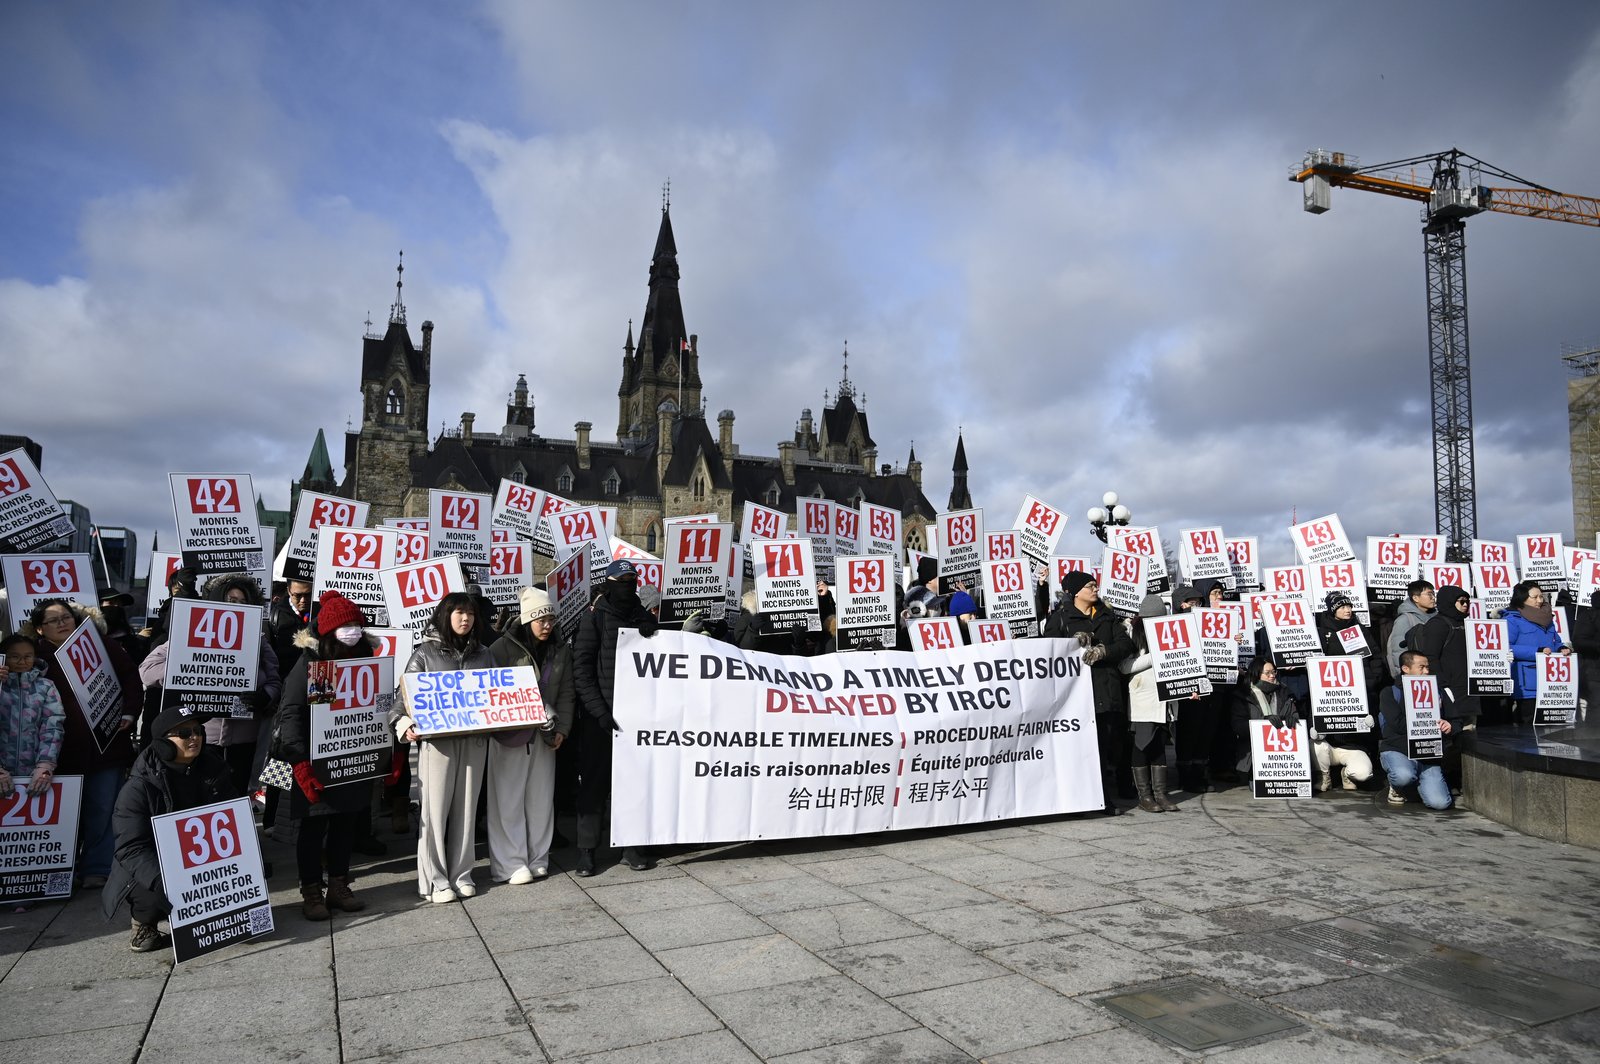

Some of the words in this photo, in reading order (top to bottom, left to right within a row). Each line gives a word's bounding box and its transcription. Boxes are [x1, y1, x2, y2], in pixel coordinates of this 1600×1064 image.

[196, 480, 235, 512] 42
[508, 487, 532, 510] 25
[199, 517, 238, 525] MONTHS
[315, 501, 350, 527] 39
[446, 498, 477, 529] 42
[754, 509, 775, 538] 34
[809, 504, 827, 533] 15
[873, 510, 893, 539] 53
[1030, 504, 1054, 533] 33
[191, 527, 230, 536] WAITING
[564, 514, 594, 542] 22
[838, 512, 856, 539] 31
[951, 517, 972, 544] 68
[1306, 523, 1331, 544] 43
[187, 538, 207, 546] IRCC
[209, 536, 256, 546] RESPONSE
[338, 535, 377, 568] 32
[685, 530, 713, 562] 11
[992, 536, 1011, 560] 55
[1128, 534, 1150, 555] 33
[1194, 532, 1216, 553] 34
[1228, 543, 1247, 562] 38
[1532, 539, 1551, 557] 27
[210, 552, 246, 560] TIMELINE
[215, 560, 248, 568] RESULTS
[492, 547, 520, 575] 37
[769, 545, 799, 576] 71
[1381, 543, 1405, 564] 65
[1485, 545, 1504, 562] 63
[29, 561, 74, 593] 36
[561, 554, 583, 599] 31
[681, 567, 712, 575] MONTHS
[854, 561, 881, 592] 53
[995, 564, 1021, 591] 68
[1115, 555, 1136, 581] 39
[1323, 566, 1351, 587] 55
[1438, 569, 1458, 590] 62
[1484, 567, 1507, 587] 72
[405, 565, 444, 605] 40
[667, 587, 683, 596] IRCC
[684, 585, 722, 594] RESPONSE
[672, 576, 703, 585] WAITING
[1278, 570, 1301, 590] 30
[765, 590, 794, 599] WAITING
[779, 598, 814, 607] RESPONSE
[852, 596, 880, 604] MONTHS
[842, 616, 856, 625] IRCC
[858, 614, 891, 623] RESPONSE
[845, 606, 873, 614] WAITING
[1275, 603, 1302, 625] 24
[194, 609, 238, 649] 40
[923, 623, 950, 650] 34
[983, 625, 1000, 642] 51
[1161, 621, 1186, 649] 41
[1204, 613, 1227, 638] 33
[1344, 632, 1357, 640] 24
[1478, 624, 1498, 649] 34
[72, 634, 98, 682] 20
[192, 653, 235, 663] MONTHS
[1160, 660, 1184, 669] WAITING
[1164, 651, 1190, 660] MONTHS
[180, 664, 224, 674] WAITING
[226, 666, 245, 676] FOR
[417, 672, 465, 692] STOP
[473, 669, 514, 687] THE
[632, 652, 688, 678] WE
[700, 654, 832, 692] DEMAND
[843, 669, 864, 690] A
[865, 664, 965, 688] TIMELY
[974, 656, 1080, 682] DECISION
[1158, 670, 1172, 678] IRCC
[1173, 666, 1202, 676] RESPONSE
[1324, 661, 1350, 686] 40
[1549, 658, 1568, 681] 35
[172, 676, 195, 685] IRCC
[197, 677, 250, 687] RESPONSE
[335, 666, 374, 708] 40
[766, 687, 897, 717] DELAYED
[904, 693, 939, 714] BY
[947, 687, 1011, 710] IRCC
[1414, 680, 1430, 708] 22
[334, 712, 373, 726] MONTHS
[324, 726, 364, 740] WAITING
[366, 723, 383, 733] FOR
[637, 730, 783, 747] REASONABLE
[788, 731, 894, 750] TIMELINES
[914, 725, 1013, 745] PROCEDURAL
[1017, 718, 1080, 738] FAIRNESS
[1267, 726, 1293, 751] 43
[318, 740, 339, 754] IRCC
[340, 734, 388, 750] RESPONSE
[327, 760, 338, 769] NO
[340, 752, 379, 766] TIMELINES
[331, 770, 341, 779] NO
[343, 764, 375, 776] RESULTS
[695, 761, 760, 777] Délais
[766, 759, 891, 778] raisonnables
[911, 754, 961, 774] Équité
[964, 747, 1043, 770] procédurale
[788, 785, 885, 811] 给出时限
[908, 777, 988, 803] 程序公平
[2, 785, 54, 825] 20
[184, 811, 234, 865] 36
[192, 864, 238, 886] MONTHS
[182, 881, 229, 903] WAITING
[232, 874, 252, 890] FOR
[177, 904, 203, 921] IRCC
[205, 886, 261, 912] RESPONSE
[192, 925, 206, 937] NO
[199, 936, 212, 948] NO
[214, 923, 251, 943] RESULTS
